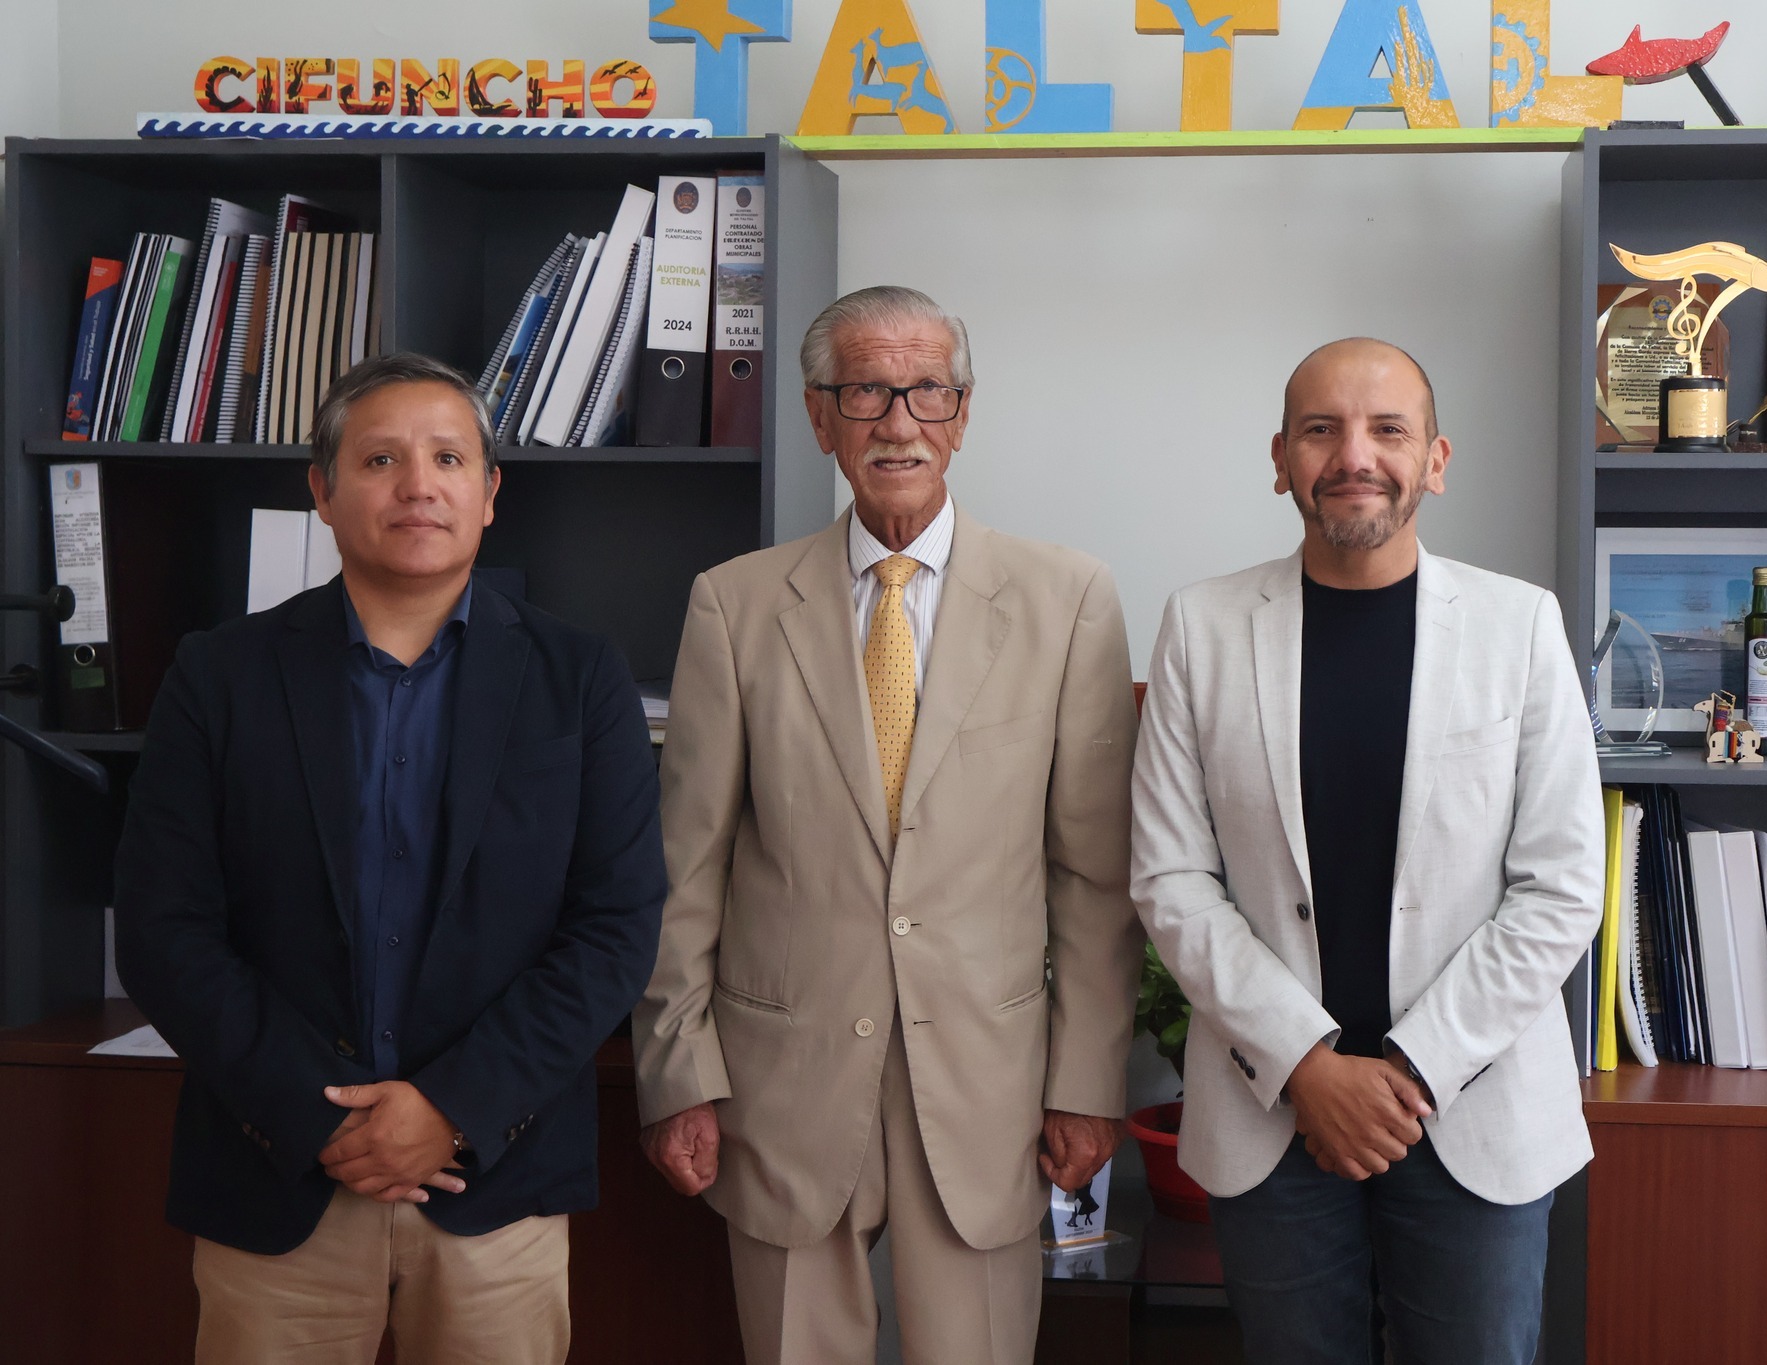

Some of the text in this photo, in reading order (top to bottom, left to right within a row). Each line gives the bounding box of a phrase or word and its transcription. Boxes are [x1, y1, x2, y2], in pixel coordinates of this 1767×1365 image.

[649, 0, 1623, 138] TALTAL
[194, 56, 656, 119] CIFUNCHO
[657, 264, 706, 276] AUDITORIA
[661, 276, 701, 287] EXTERNA
[732, 308, 754, 318] 2021
[663, 319, 692, 331] 2024
[725, 326, 762, 335] R.R.H.H.
[729, 339, 757, 347] D.O.M.
